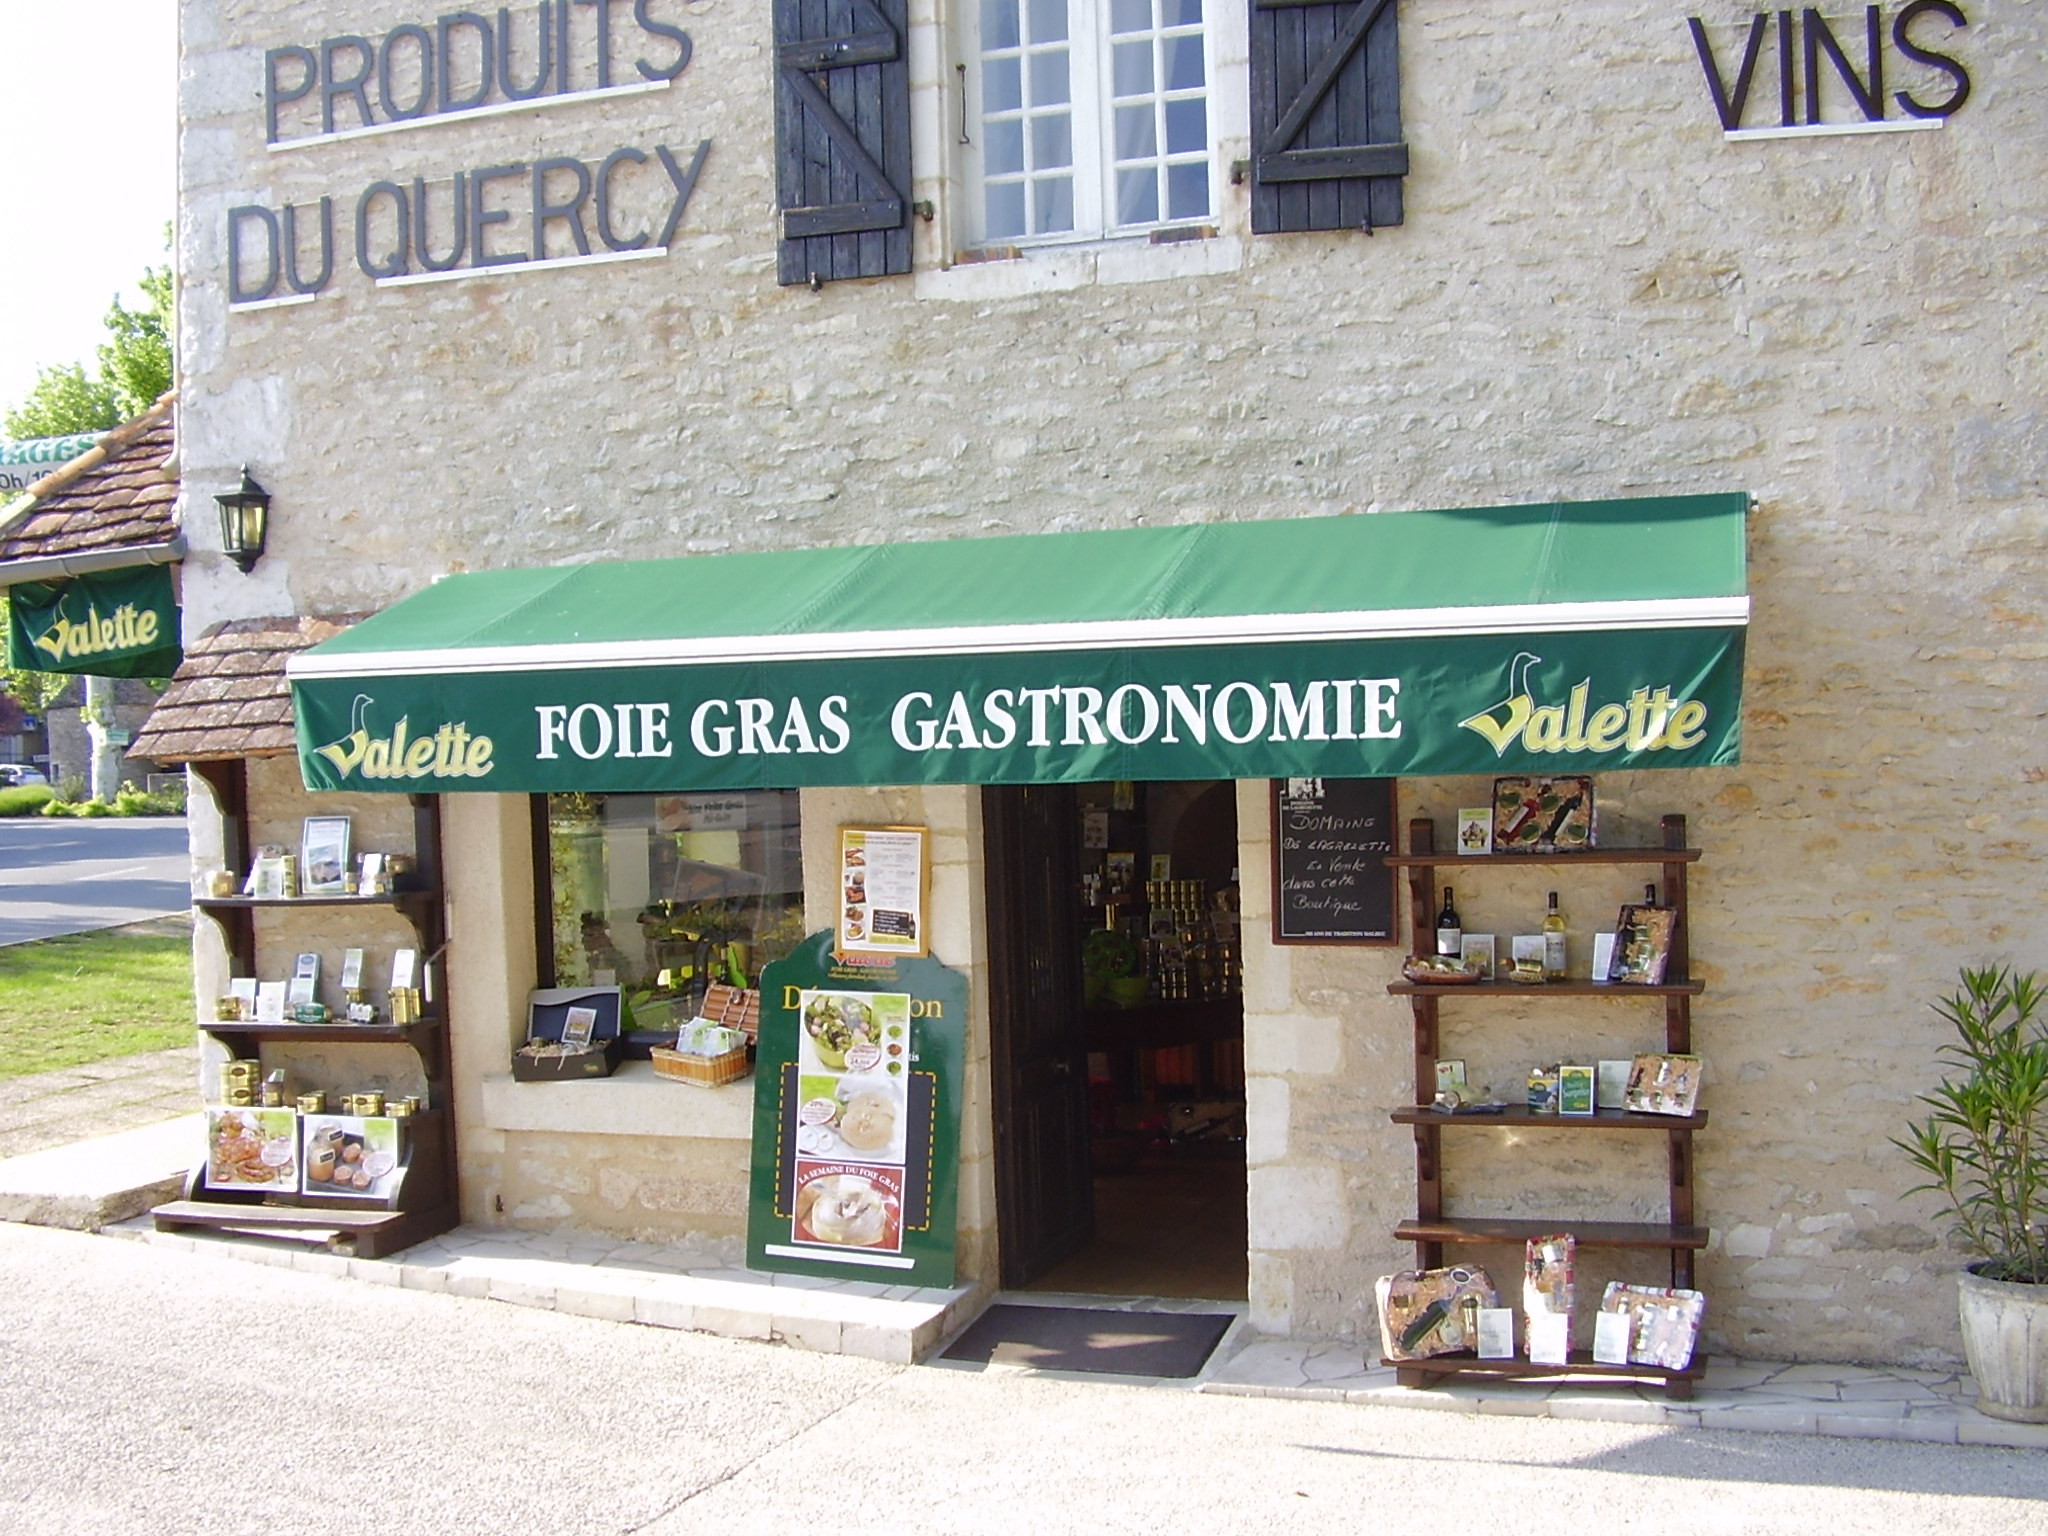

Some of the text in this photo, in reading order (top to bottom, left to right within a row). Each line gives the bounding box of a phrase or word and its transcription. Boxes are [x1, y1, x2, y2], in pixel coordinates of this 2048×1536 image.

[265, 0, 692, 144] PRODUITS
[1687, 0, 1970, 131] VINS
[228, 139, 712, 301] DU QUERCY
[35, 602, 158, 662] Valette
[313, 676, 1707, 780] Valette FOIE GRAS GASTRONOMIE Valette
[1292, 894, 1362, 917] Boutique
[860, 1168, 878, 1181] FOIE
[878, 1174, 899, 1193] GRAS
